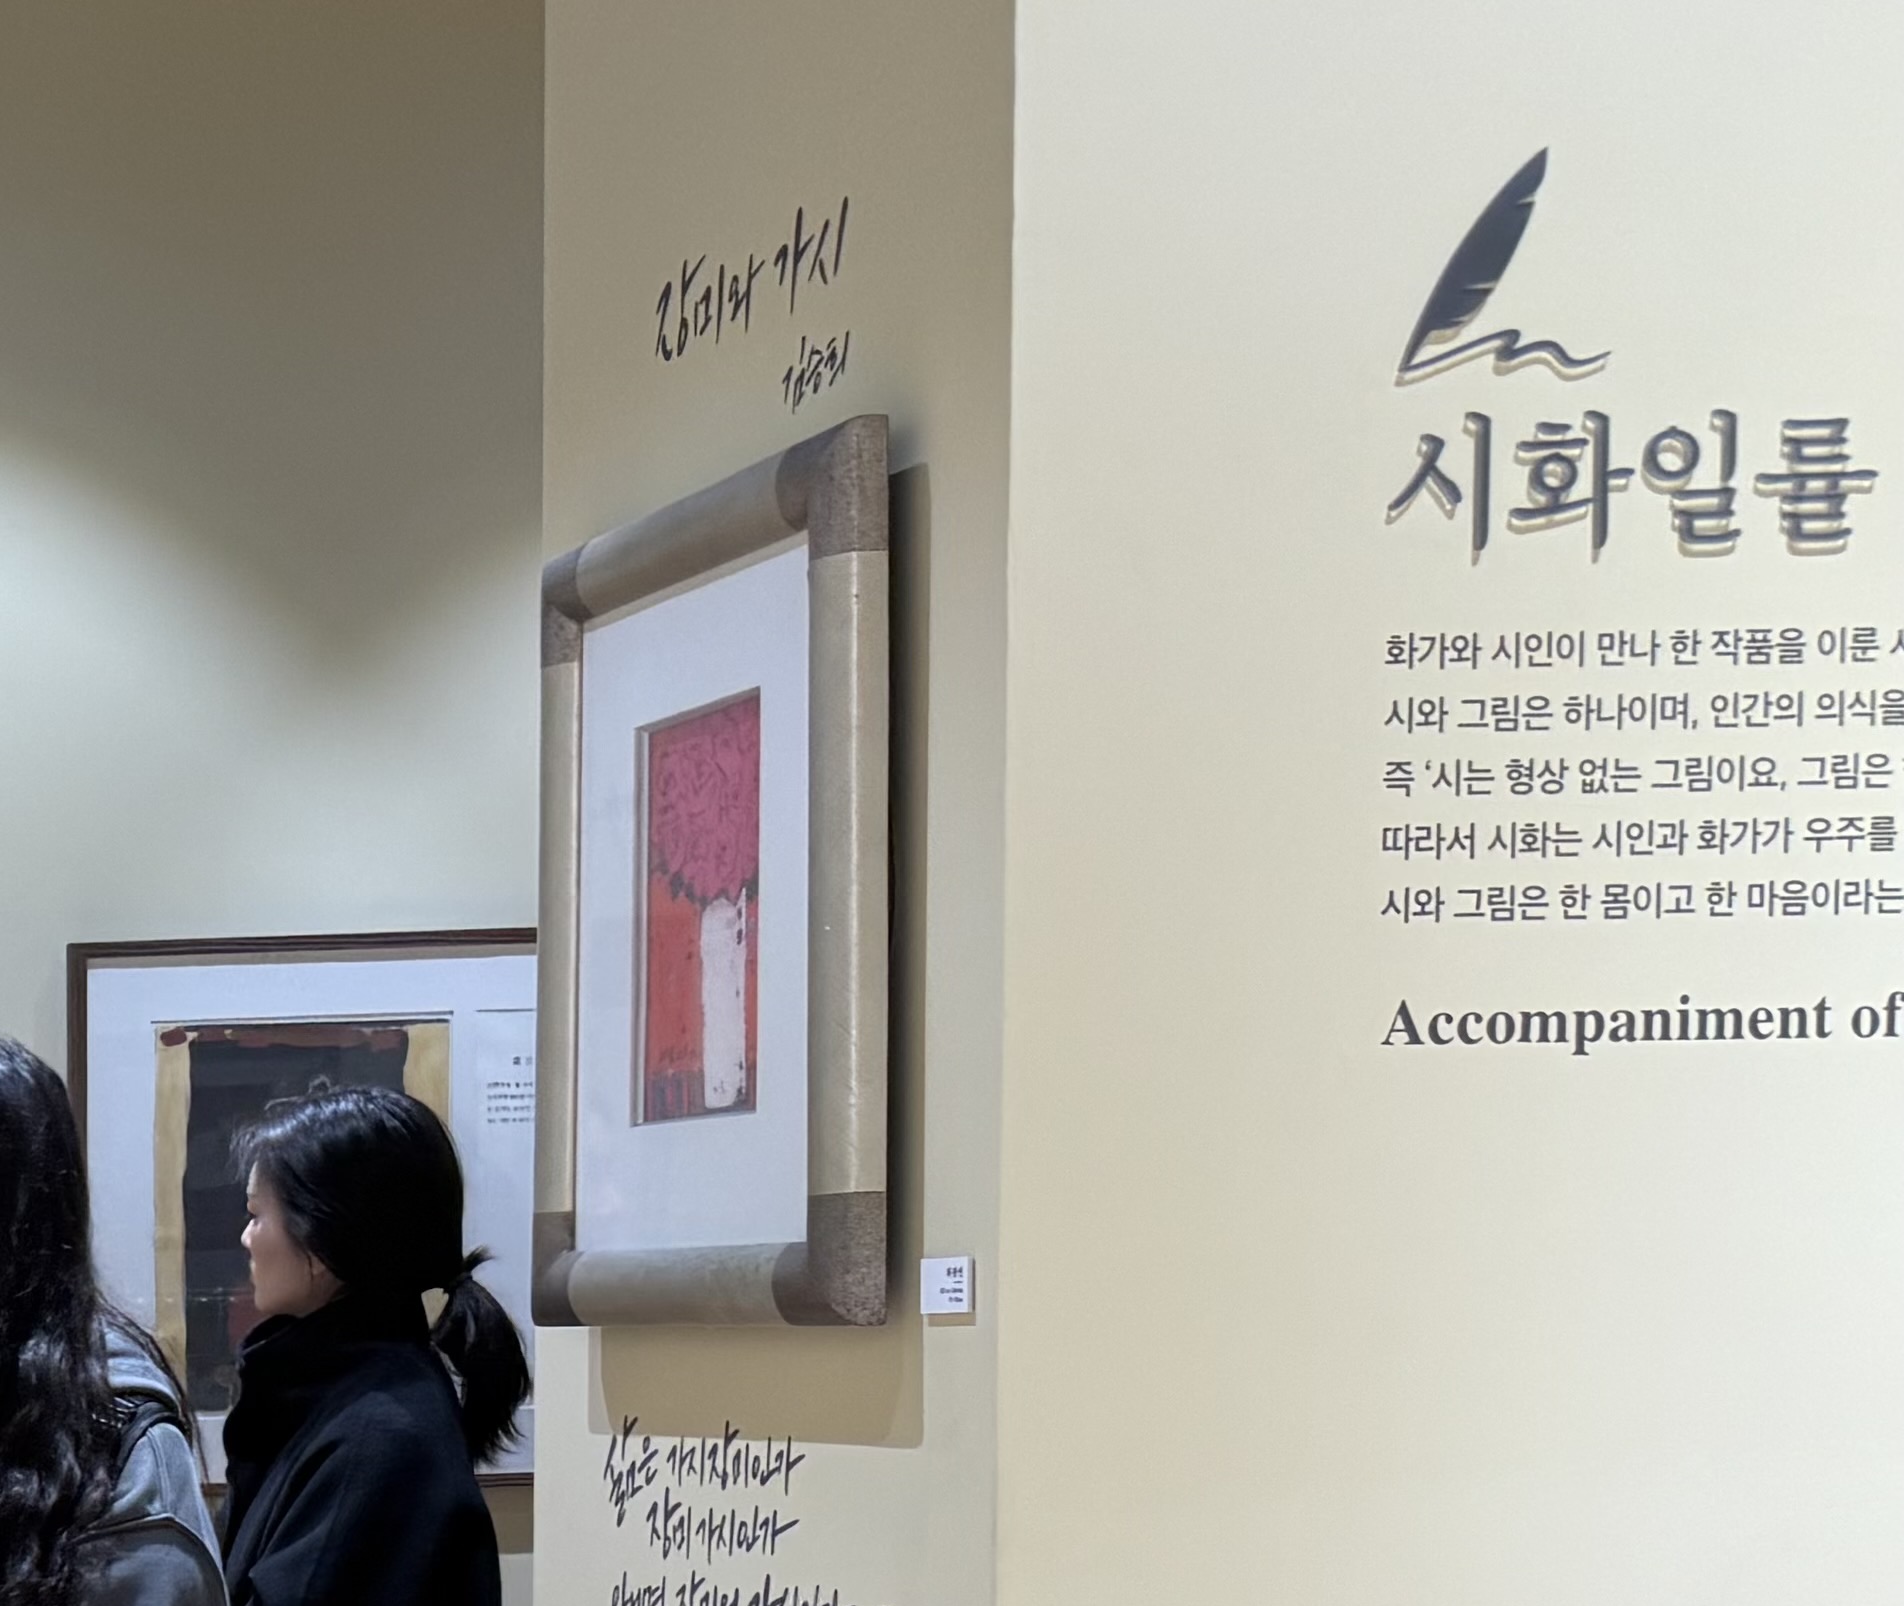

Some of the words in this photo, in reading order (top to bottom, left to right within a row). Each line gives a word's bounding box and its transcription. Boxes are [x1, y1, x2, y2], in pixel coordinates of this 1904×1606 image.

[1385, 409, 1879, 566] 시화일률
[1384, 631, 1483, 671] 화가와
[1491, 630, 1586, 670] 시인이
[1597, 629, 1662, 668] 만나
[1669, 628, 1704, 667] 한
[1710, 627, 1807, 666] 작품을
[1817, 625, 1881, 665] 이룬
[1383, 695, 1450, 735] 시와
[1456, 694, 1554, 733] 그림은
[1562, 692, 1699, 732] 하나이며,
[1710, 690, 1805, 730] 인간의
[1814, 688, 1904, 728] 의식을
[1382, 760, 1416, 798] 즉
[1504, 757, 1571, 796] 형상
[1578, 756, 1643, 796] 없는
[1650, 754, 1788, 793] 그림이요,
[1796, 752, 1894, 791] 그림은
[1381, 822, 1477, 862] 따라서
[1487, 820, 1584, 860] 시화는
[1591, 818, 1690, 858] 시인과
[1696, 817, 1795, 856] 화가가
[1802, 814, 1900, 854] 우주를
[1380, 885, 1446, 924] 시와
[1452, 884, 1550, 923] 그림은
[1558, 882, 1592, 921] 한
[1599, 881, 1696, 920] 몸이고
[1703, 880, 1738, 919] 한
[1747, 878, 1904, 918] 마음이라는
[1380, 993, 1834, 1057] Accompaniment
[1850, 990, 1904, 1040] of
